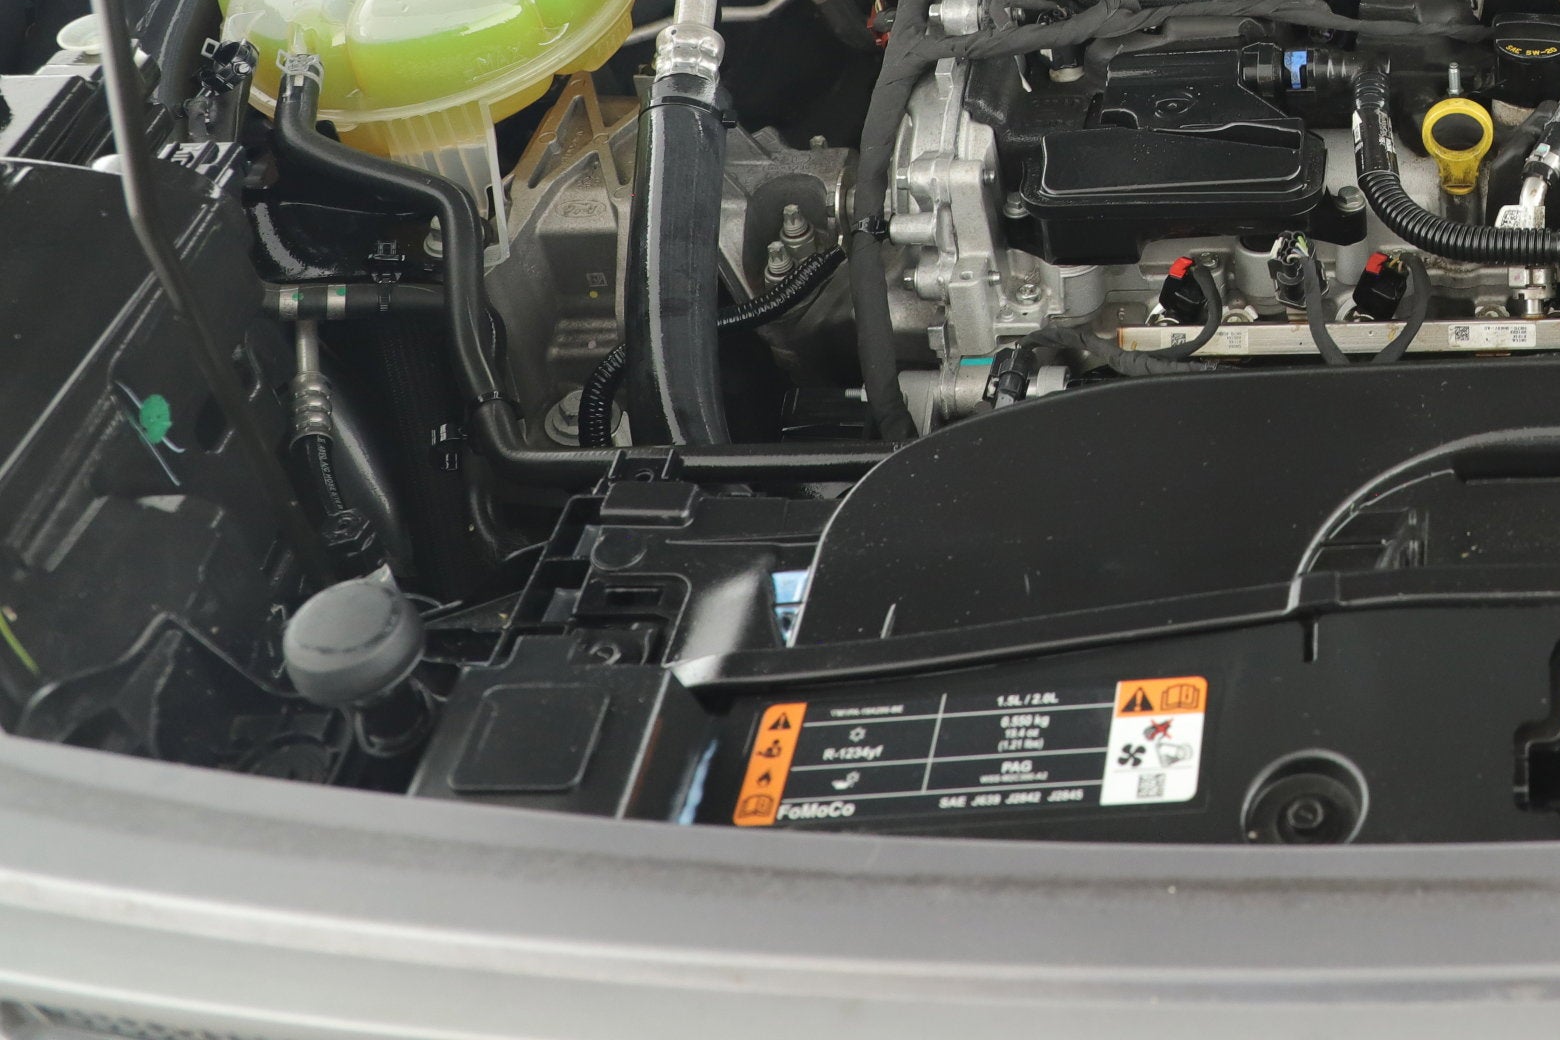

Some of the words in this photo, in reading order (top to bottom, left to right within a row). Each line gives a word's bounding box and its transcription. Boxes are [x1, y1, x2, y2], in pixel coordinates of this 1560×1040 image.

[1505, 45, 1522, 54] SAE
[1526, 47, 1558, 56] 5W-20
[997, 694, 1023, 707] 1.5L
[1031, 692, 1059, 705] 2.0L
[1034, 714, 1050, 728] kg
[822, 745, 883, 761] R-1234yf
[1001, 760, 1033, 773] PAG
[939, 795, 967, 809] SAE
[776, 802, 855, 820] FoMoCo
